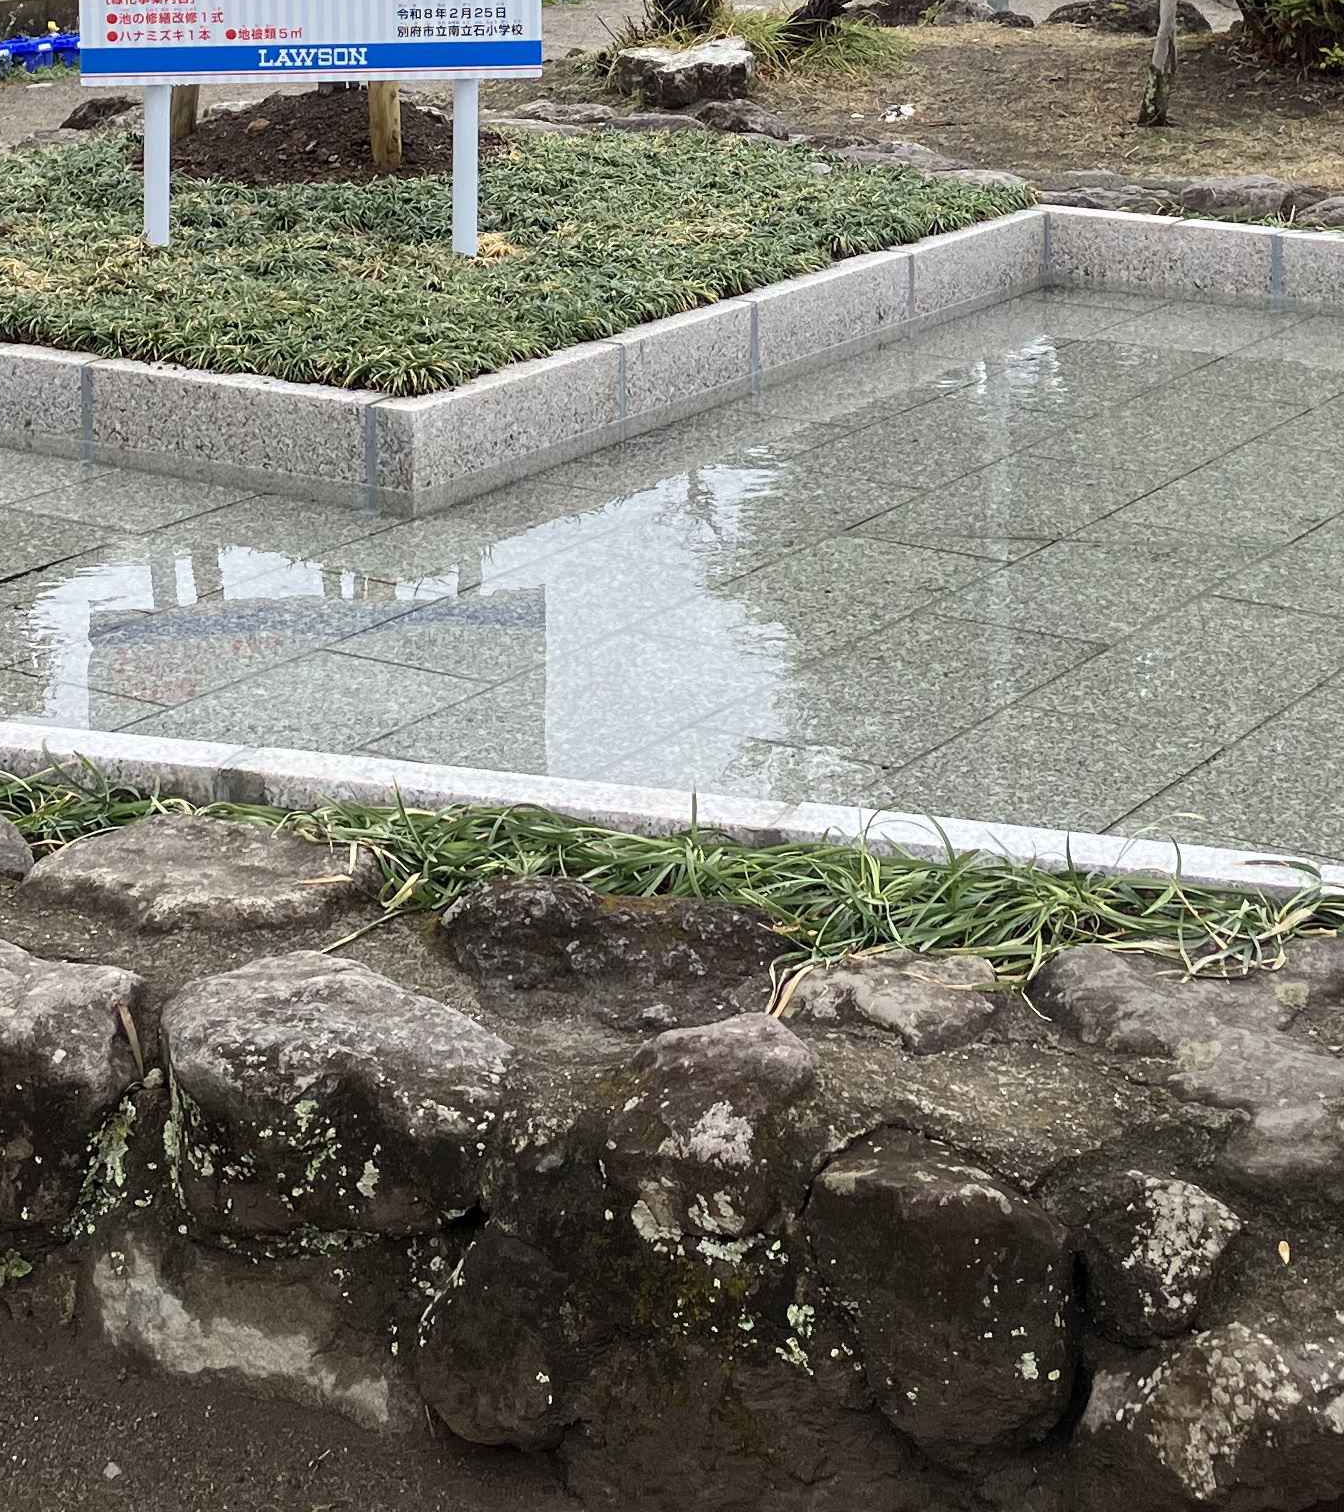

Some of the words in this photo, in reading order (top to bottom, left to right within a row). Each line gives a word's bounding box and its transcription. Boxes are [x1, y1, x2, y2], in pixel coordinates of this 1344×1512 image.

[397, 7, 507, 21] 令和8年2月25日
[397, 23, 523, 38] 別府市立南立石小学校
[258, 47, 368, 67] LAWSON
